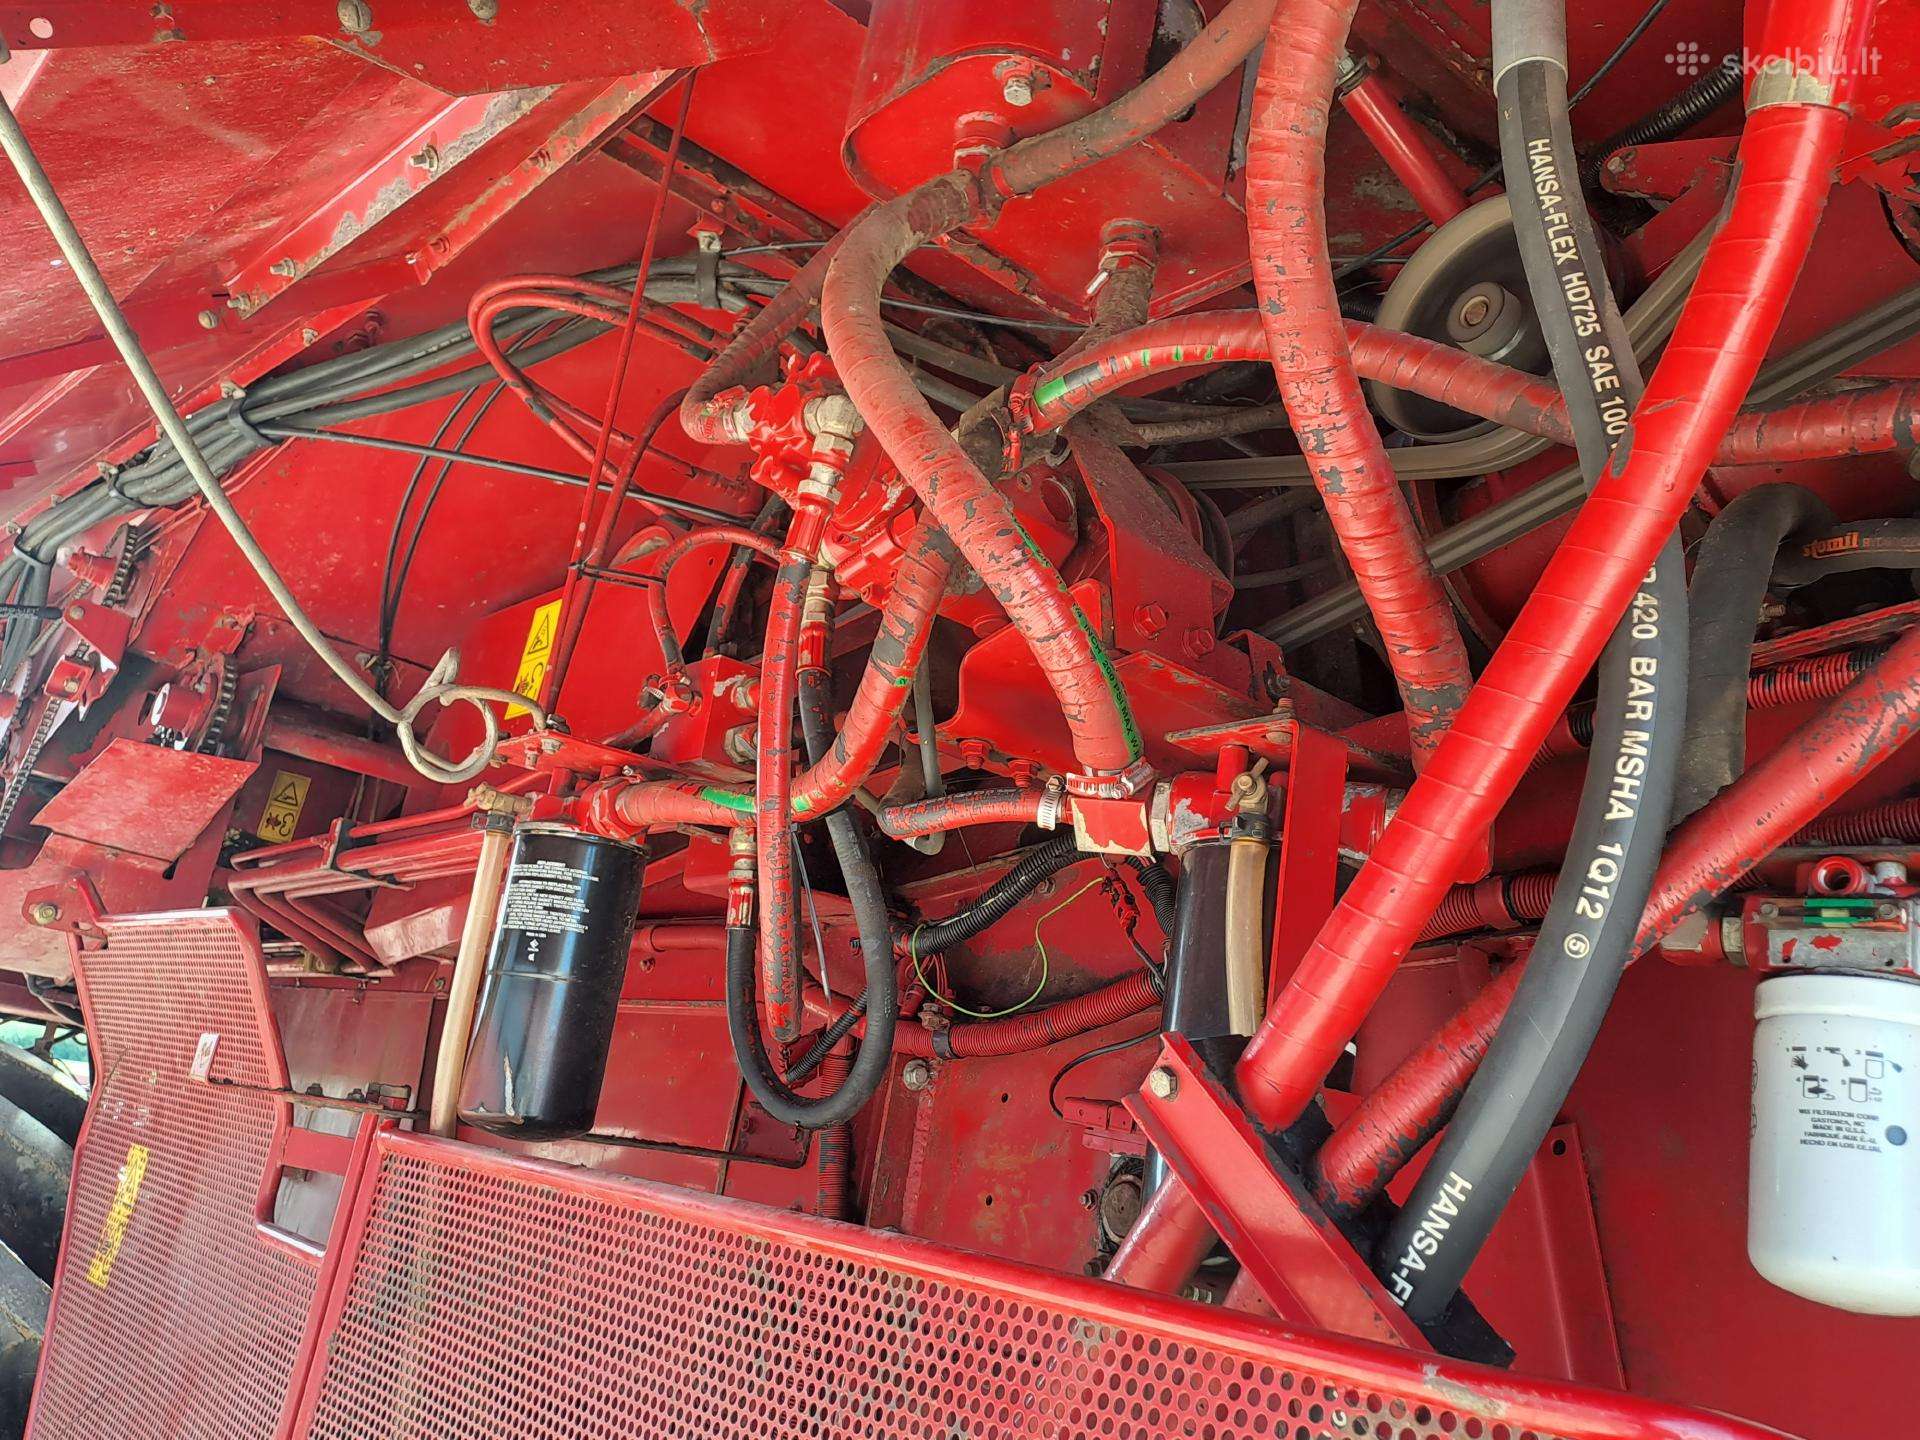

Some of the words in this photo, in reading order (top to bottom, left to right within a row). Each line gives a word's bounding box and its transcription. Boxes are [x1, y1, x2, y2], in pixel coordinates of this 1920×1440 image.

[1528, 138, 1579, 266] HANSA-FLEX
[1562, 271, 1601, 337] HD725
[1584, 345, 1621, 393] SAE
[1600, 395, 1629, 436] 100
[1631, 591, 1659, 640] 420
[1102, 660, 1115, 681] 200
[1121, 705, 1134, 735] MAX
[1625, 656, 1657, 722] BAR
[1604, 730, 1650, 820] MSHA
[1574, 842, 1624, 920] 1Q12
